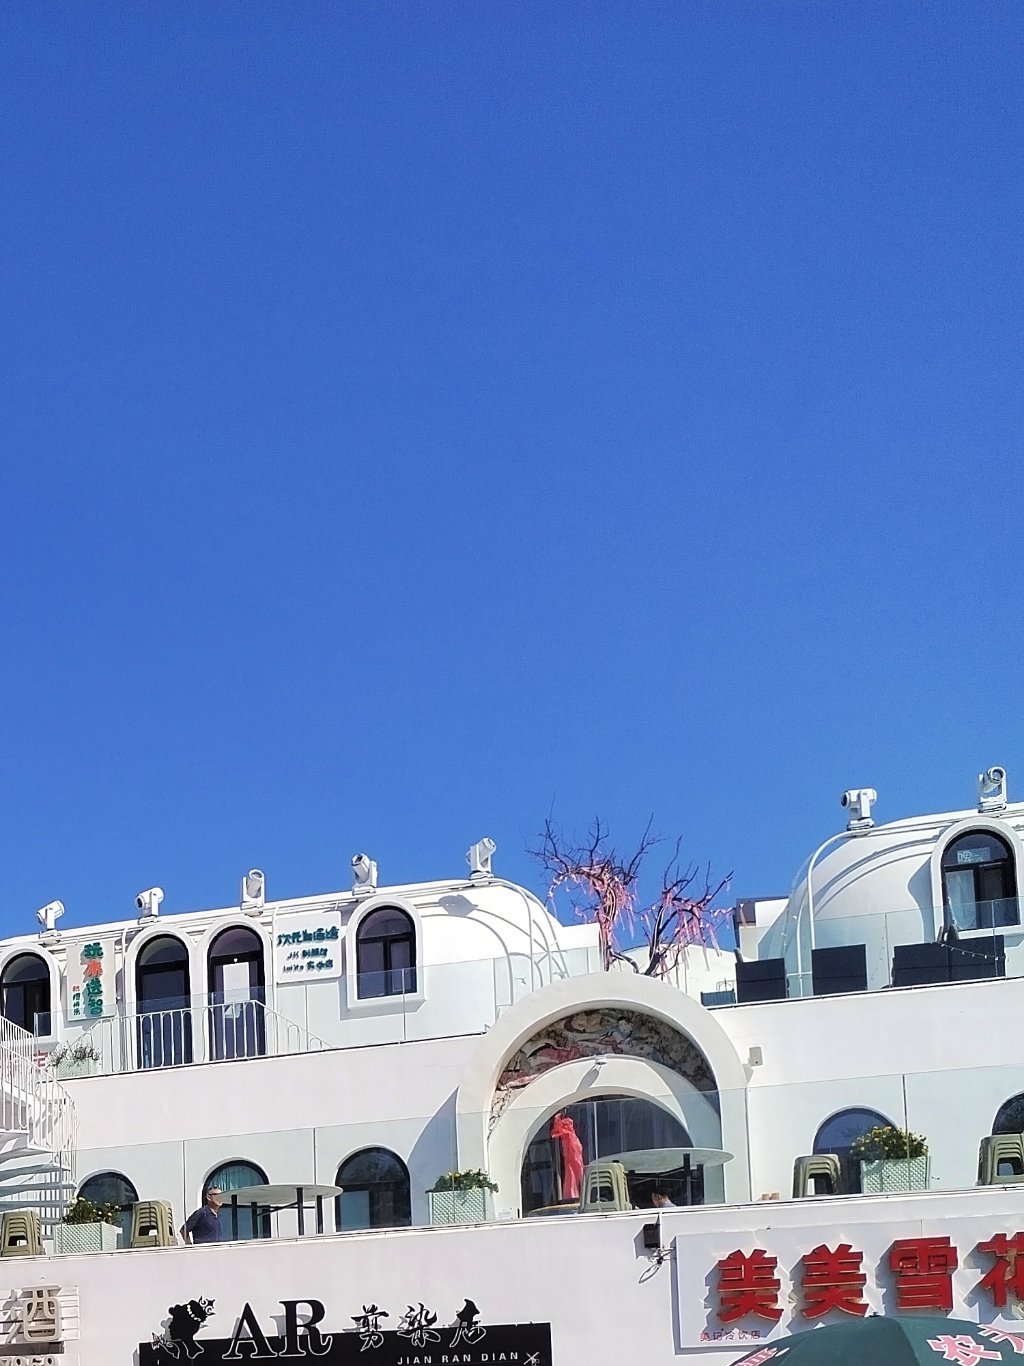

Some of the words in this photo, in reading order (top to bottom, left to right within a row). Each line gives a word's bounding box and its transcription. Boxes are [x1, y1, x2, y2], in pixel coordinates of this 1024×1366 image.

[221, 1297, 333, 1360] AR
[351, 1298, 487, 1352] 剪染店
[397, 1355, 432, 1365] JIAN
[441, 1353, 471, 1363] RAN
[481, 1351, 519, 1362] DIAN
